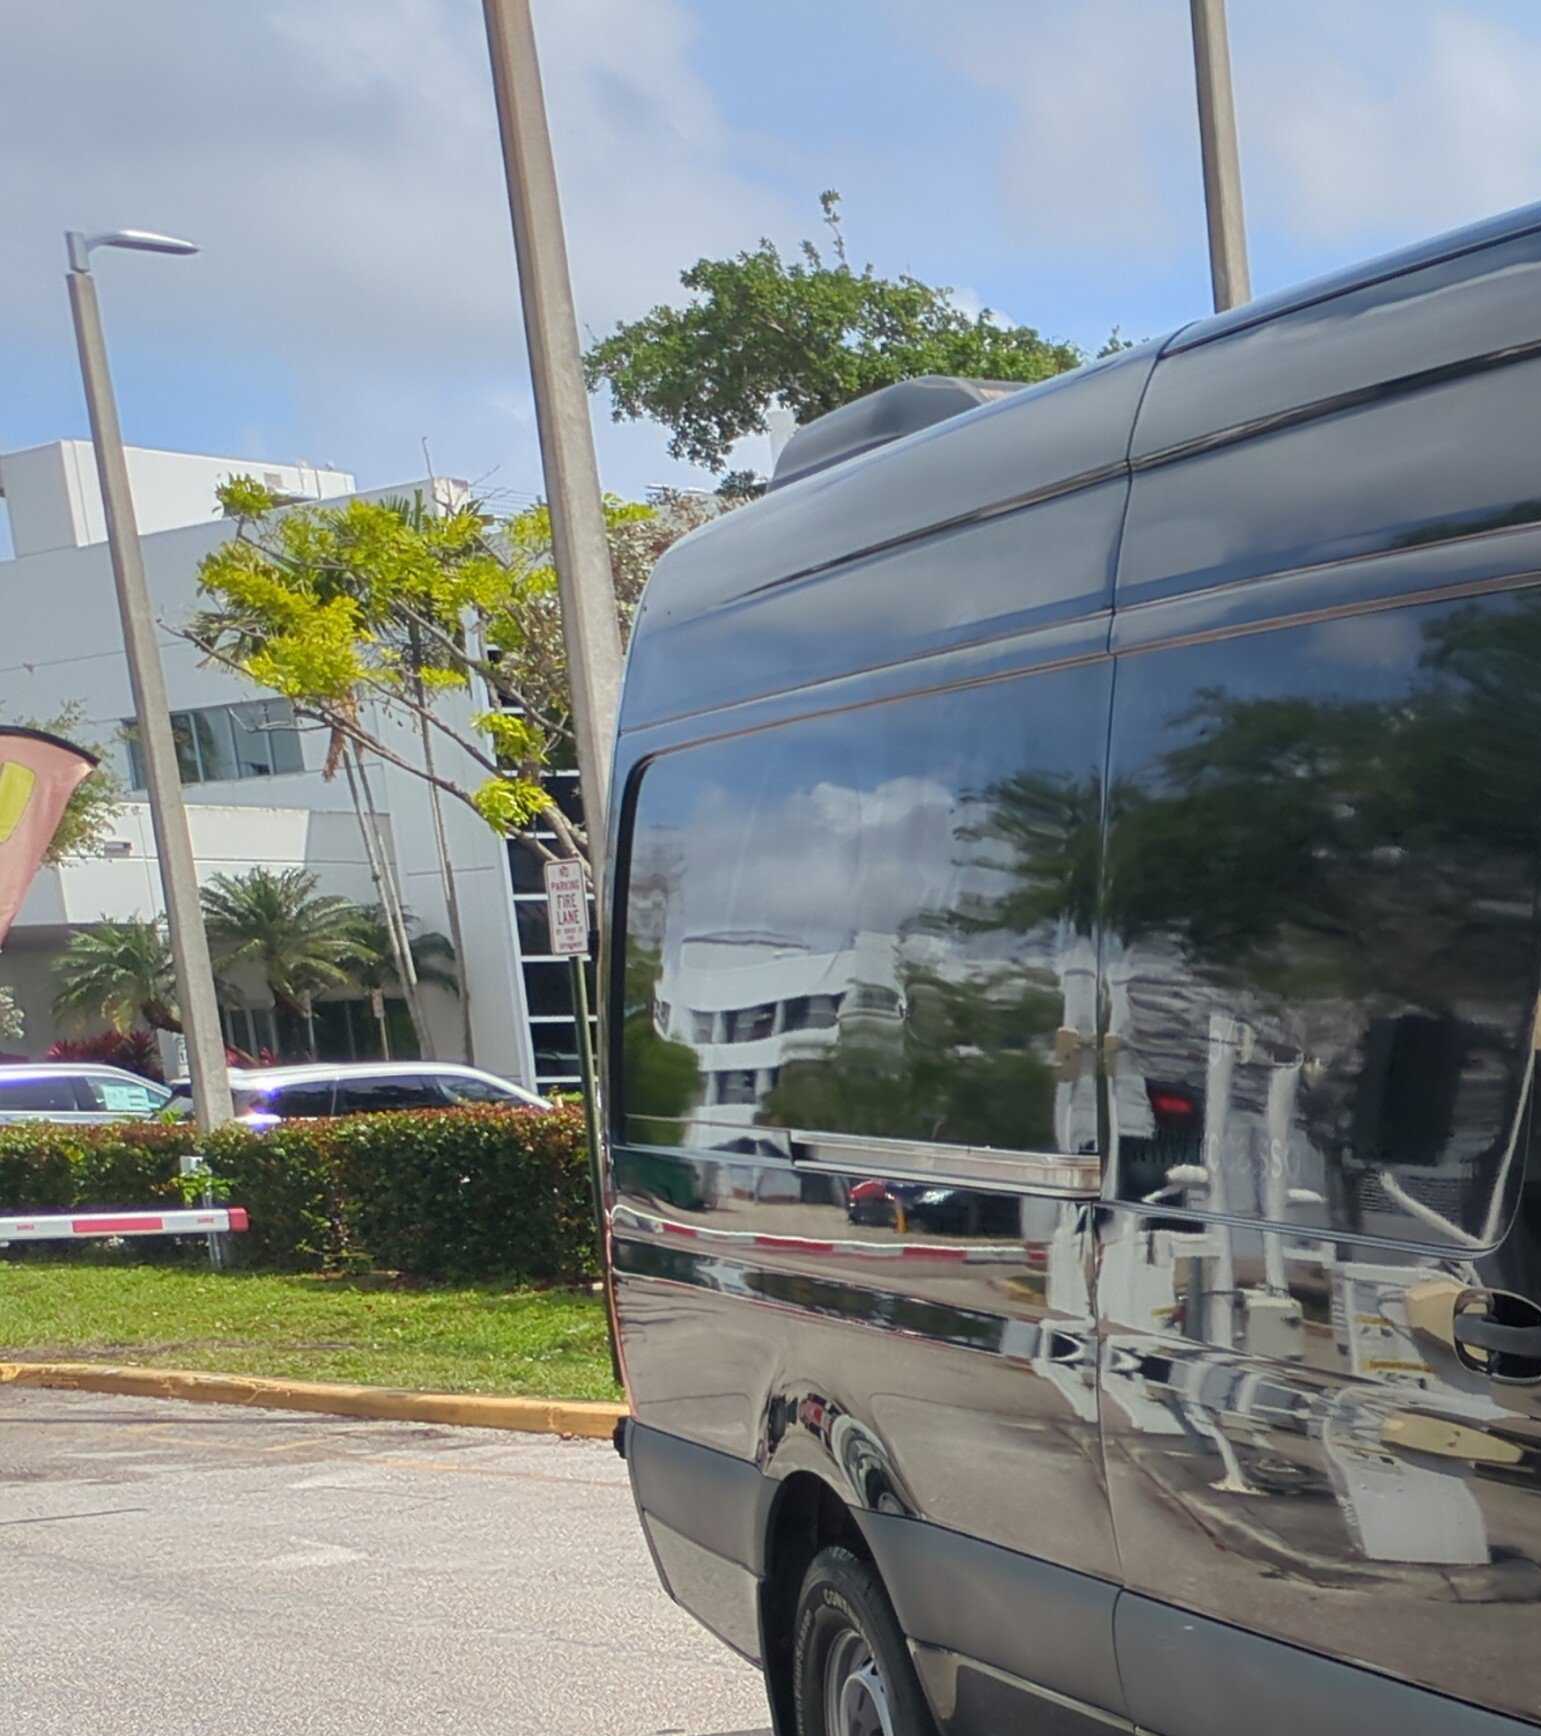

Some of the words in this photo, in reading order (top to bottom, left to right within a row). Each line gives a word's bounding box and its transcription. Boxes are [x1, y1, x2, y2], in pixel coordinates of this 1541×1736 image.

[560, 866, 569, 877] NO
[551, 880, 579, 890] PARKING
[557, 893, 576, 908] FIRE
[557, 909, 579, 925] LANE
